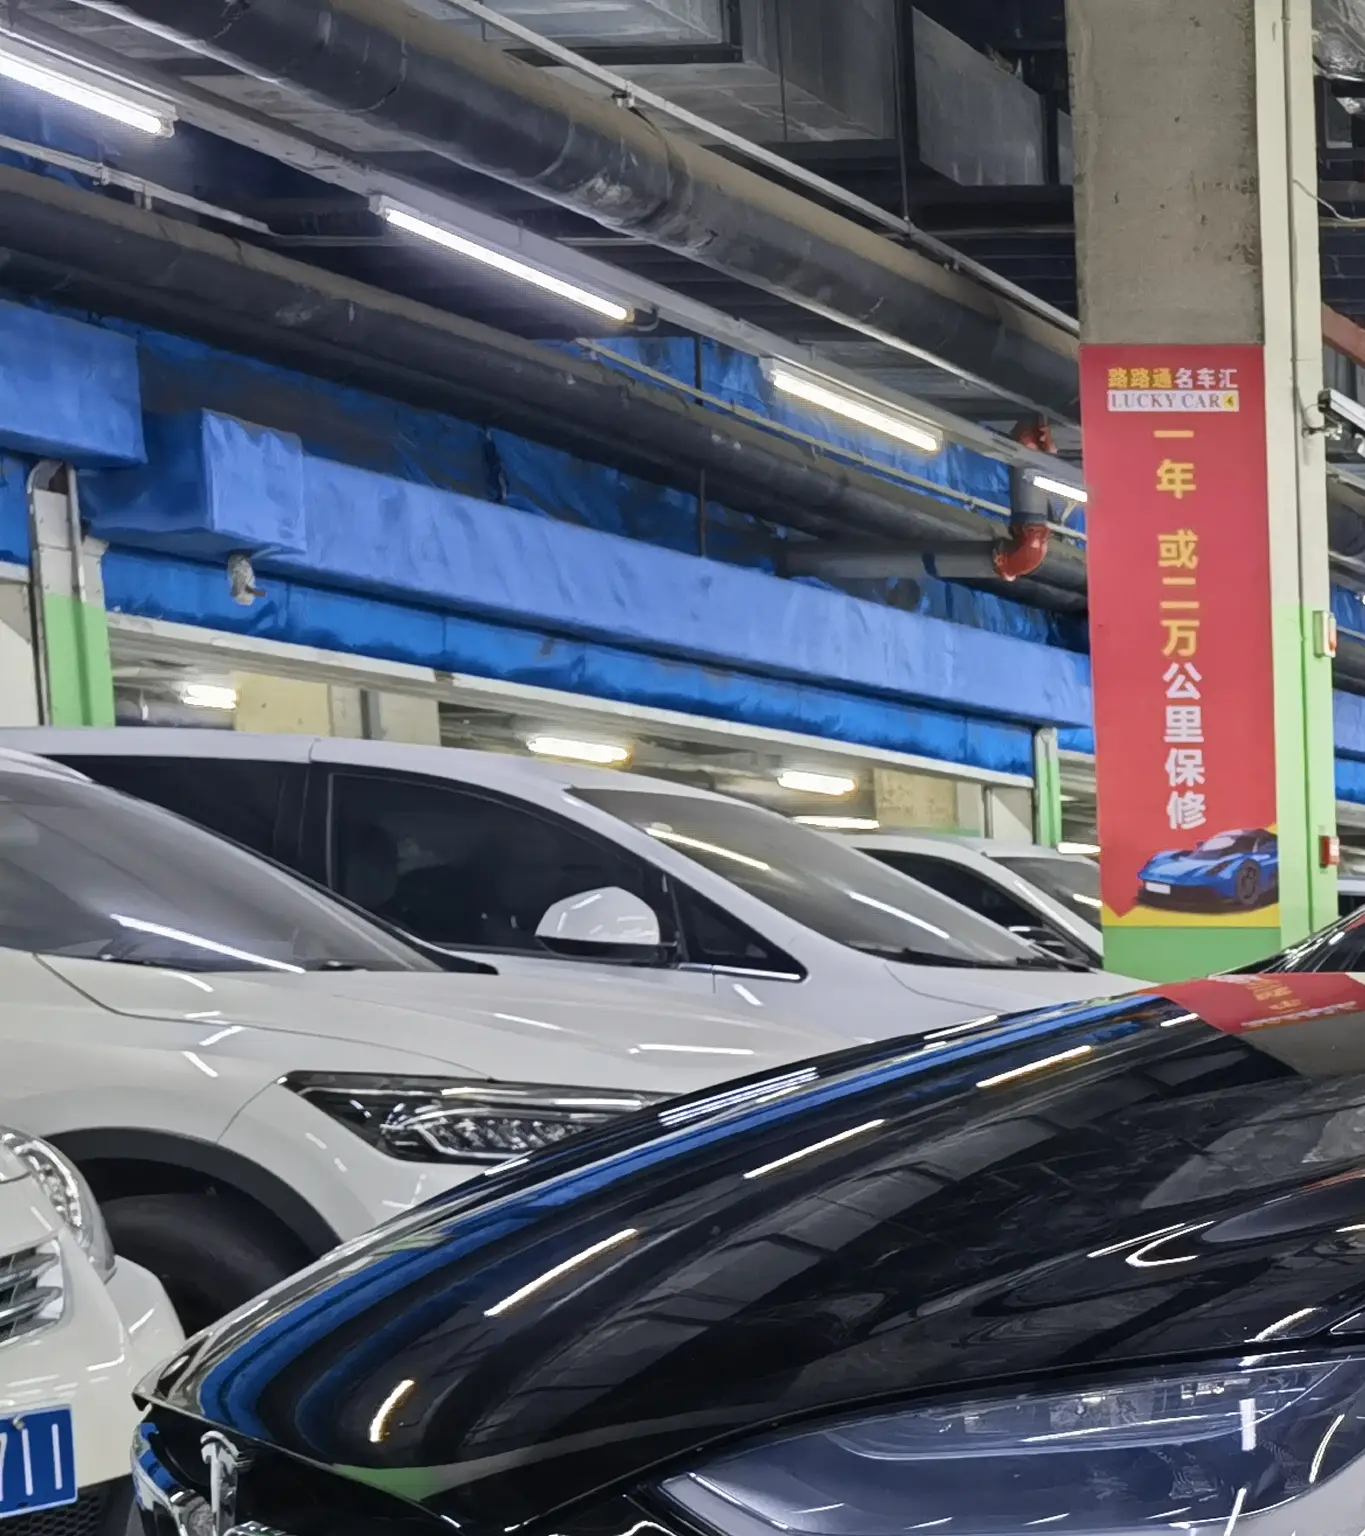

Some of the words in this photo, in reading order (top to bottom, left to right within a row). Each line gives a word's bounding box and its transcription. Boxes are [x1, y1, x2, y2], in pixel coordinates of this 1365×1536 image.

[1107, 367, 1238, 389] 路路通名车汇
[1111, 393, 1176, 409] LUCKY
[1181, 393, 1221, 409] CAR
